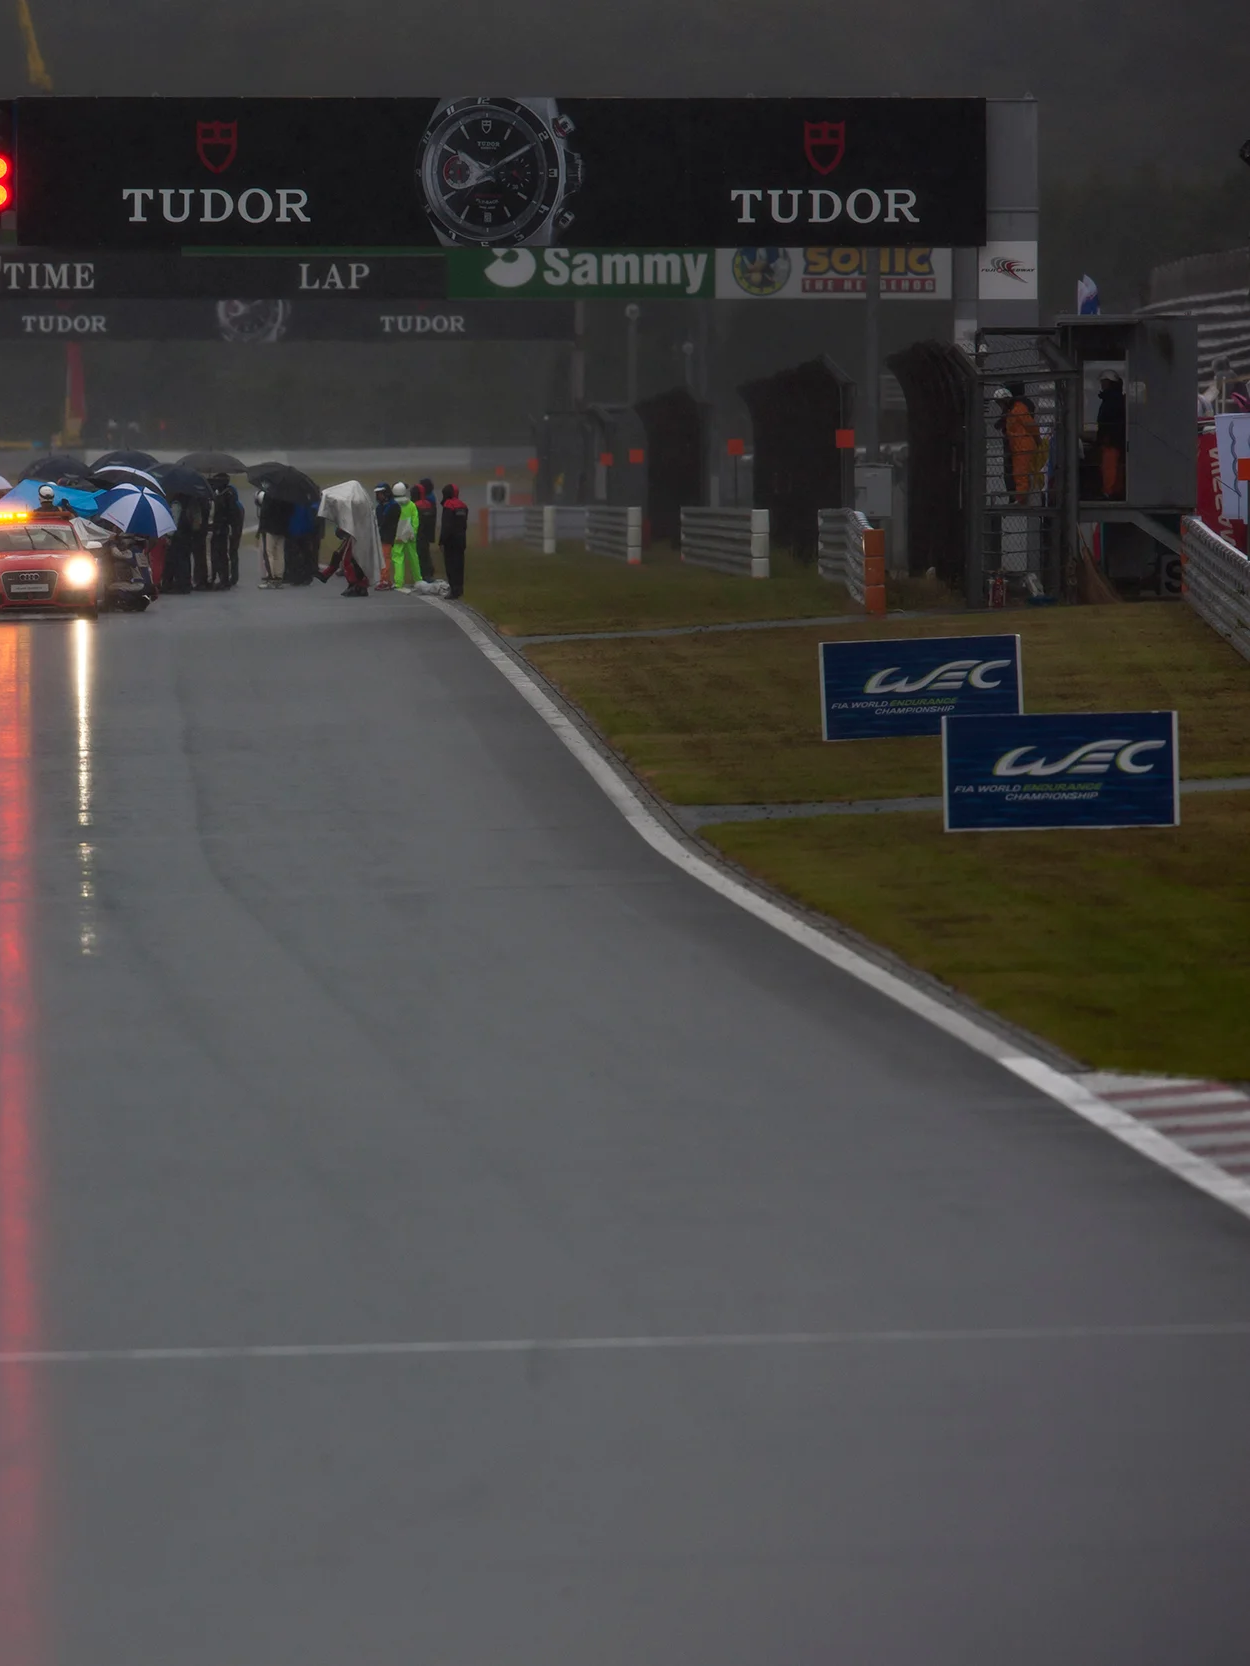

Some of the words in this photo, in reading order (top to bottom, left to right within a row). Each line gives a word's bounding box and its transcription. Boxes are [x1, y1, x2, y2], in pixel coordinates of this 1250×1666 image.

[122, 187, 311, 224] TUDOR
[730, 188, 920, 224] TUDOR
[3, 262, 95, 290] TIME
[298, 263, 370, 290] LAP
[542, 248, 708, 295] Sammy
[804, 279, 833, 291] THE
[843, 279, 934, 291] HEGEHOG
[21, 315, 107, 333] TUDOR
[379, 315, 466, 333] TUDOR
[863, 659, 1012, 694] WEC
[831, 702, 849, 710] FIA
[851, 700, 888, 709] WORLD
[889, 697, 958, 706] ENDURANCE
[874, 705, 955, 715] CHAMPIONSHIP
[992, 739, 1167, 776] WEC
[953, 785, 974, 793] FIA
[978, 784, 1021, 793] WORLD
[1022, 782, 1104, 792] ENDURANCE
[1005, 791, 1099, 801] CHAMPIONSHIP
